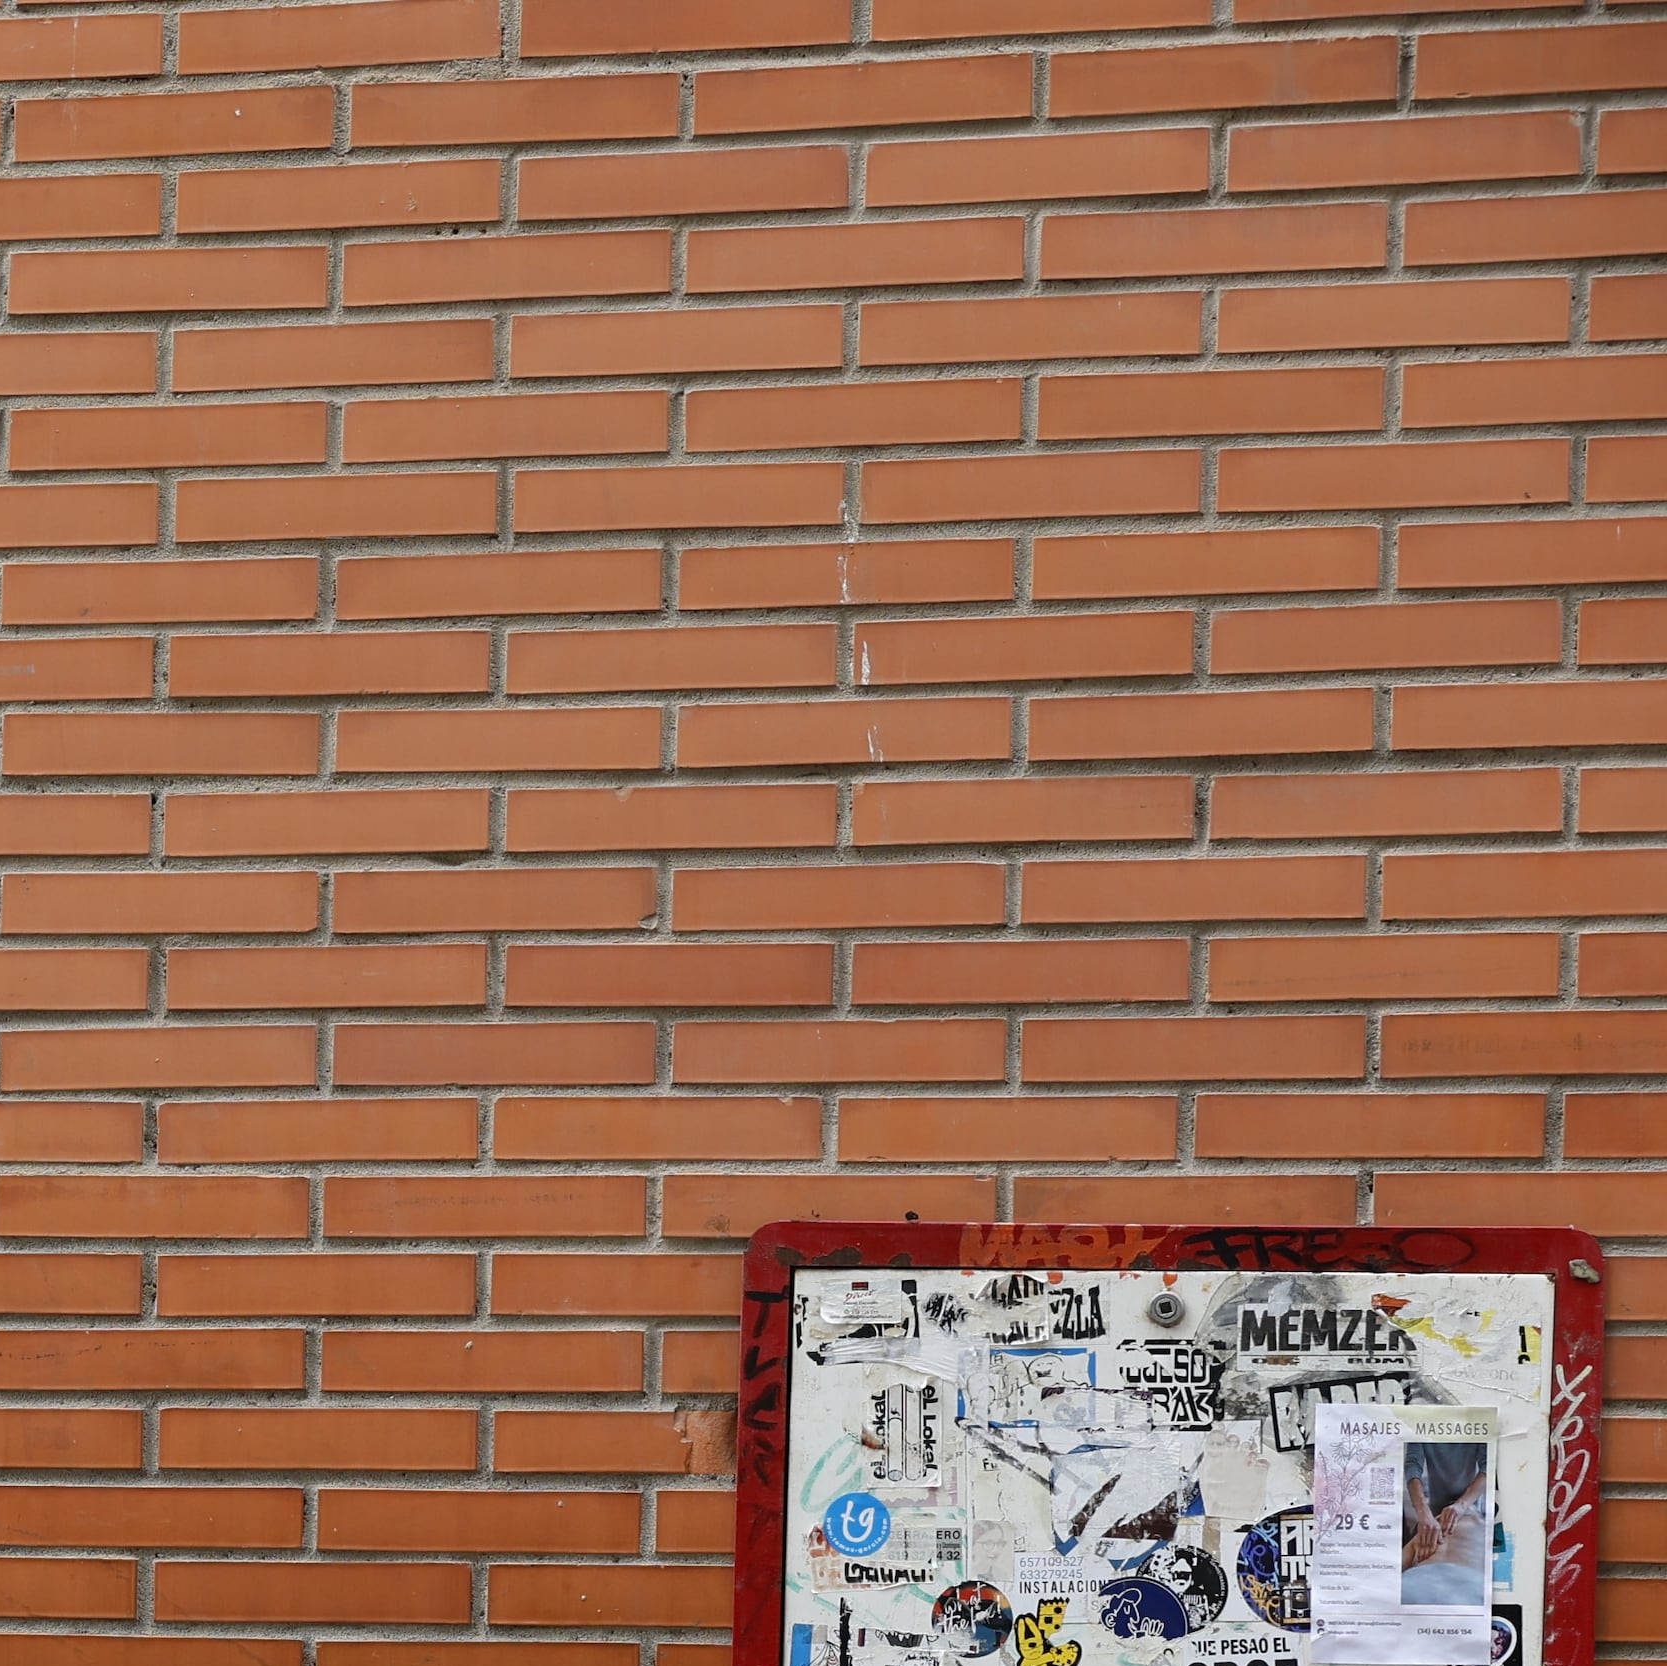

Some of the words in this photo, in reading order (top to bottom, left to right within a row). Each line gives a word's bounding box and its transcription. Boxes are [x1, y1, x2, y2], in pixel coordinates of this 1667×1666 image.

[1340, 1422, 1401, 1435] MASAJES
[1415, 1422, 1489, 1436] MASSAGES
[1335, 1514, 1354, 1530] 29
[1359, 1514, 1370, 1530] €
[1019, 1556, 1084, 1568] 657109527
[1019, 1568, 1083, 1580] 633279245
[1221, 1638, 1267, 1655] PESAO
[1273, 1636, 1291, 1653] EL
